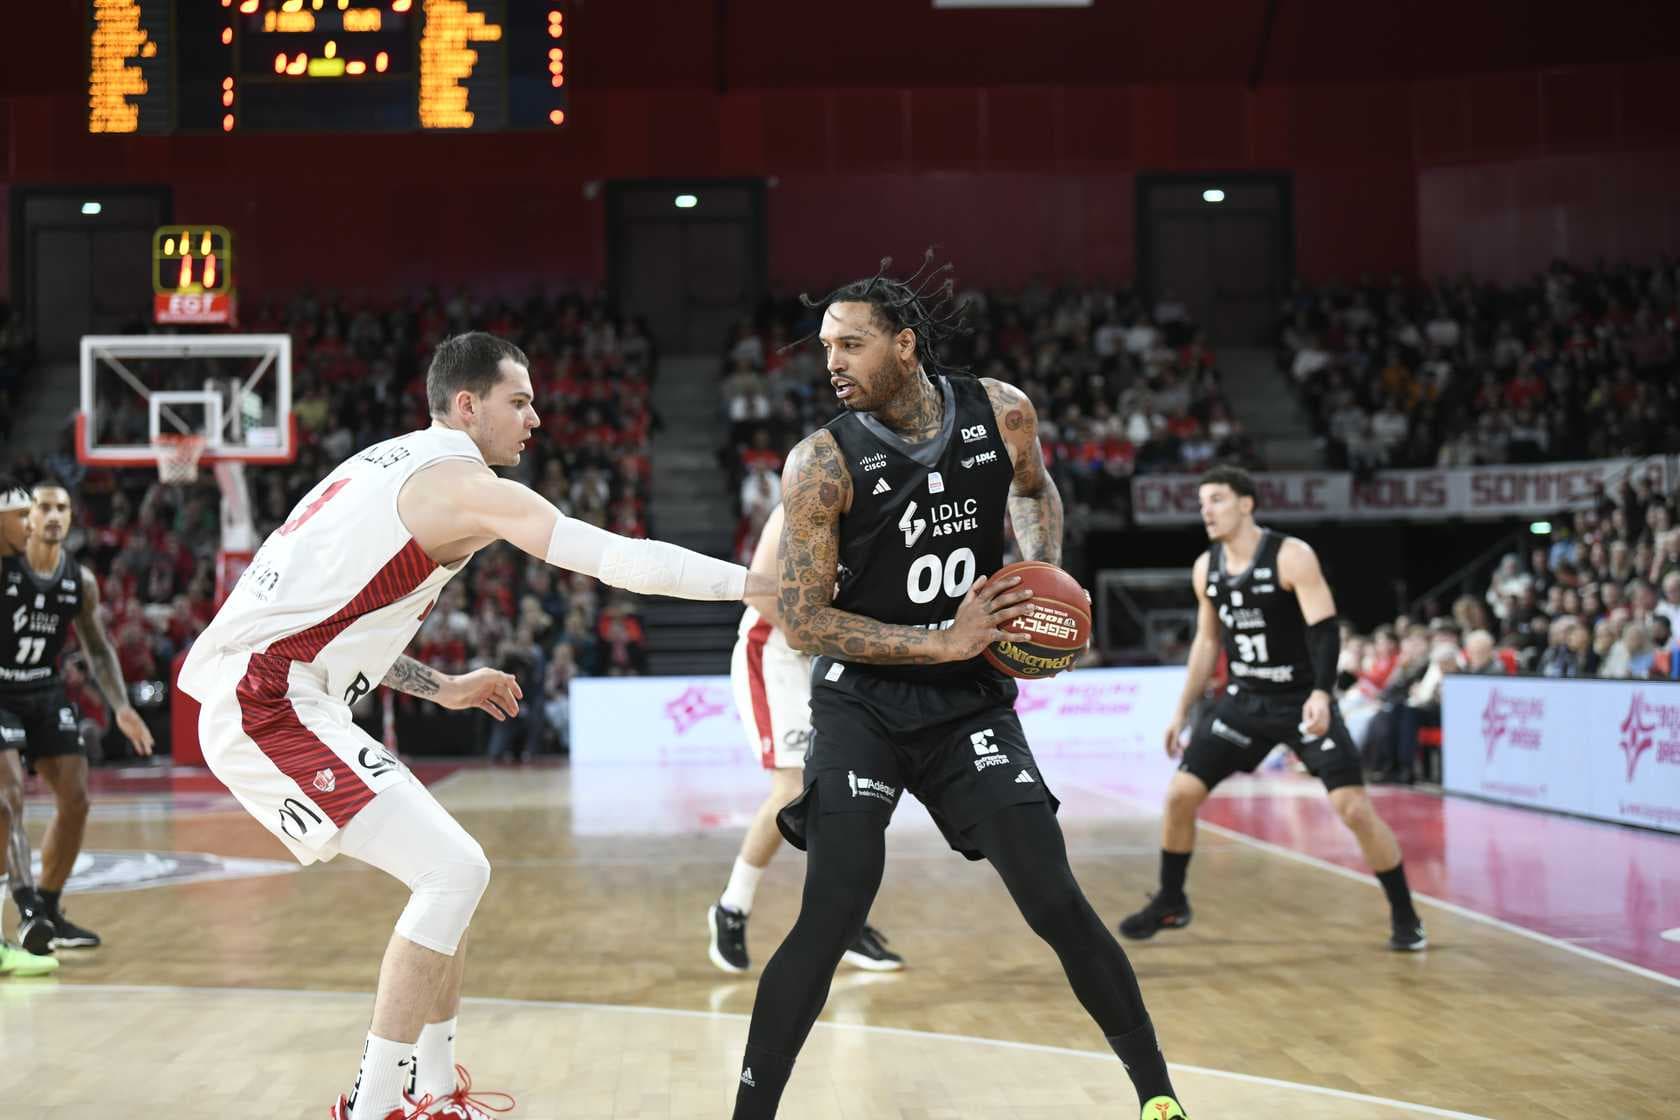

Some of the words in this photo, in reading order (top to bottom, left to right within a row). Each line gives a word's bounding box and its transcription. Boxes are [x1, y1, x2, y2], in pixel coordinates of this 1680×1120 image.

[960, 424, 987, 440] DCB
[930, 498, 978, 524] LDLC
[932, 517, 979, 537] ASVEL
[907, 547, 976, 604] 00
[1012, 616, 1079, 641] LEGACY
[15, 636, 46, 664] 11
[1234, 633, 1269, 663] 31
